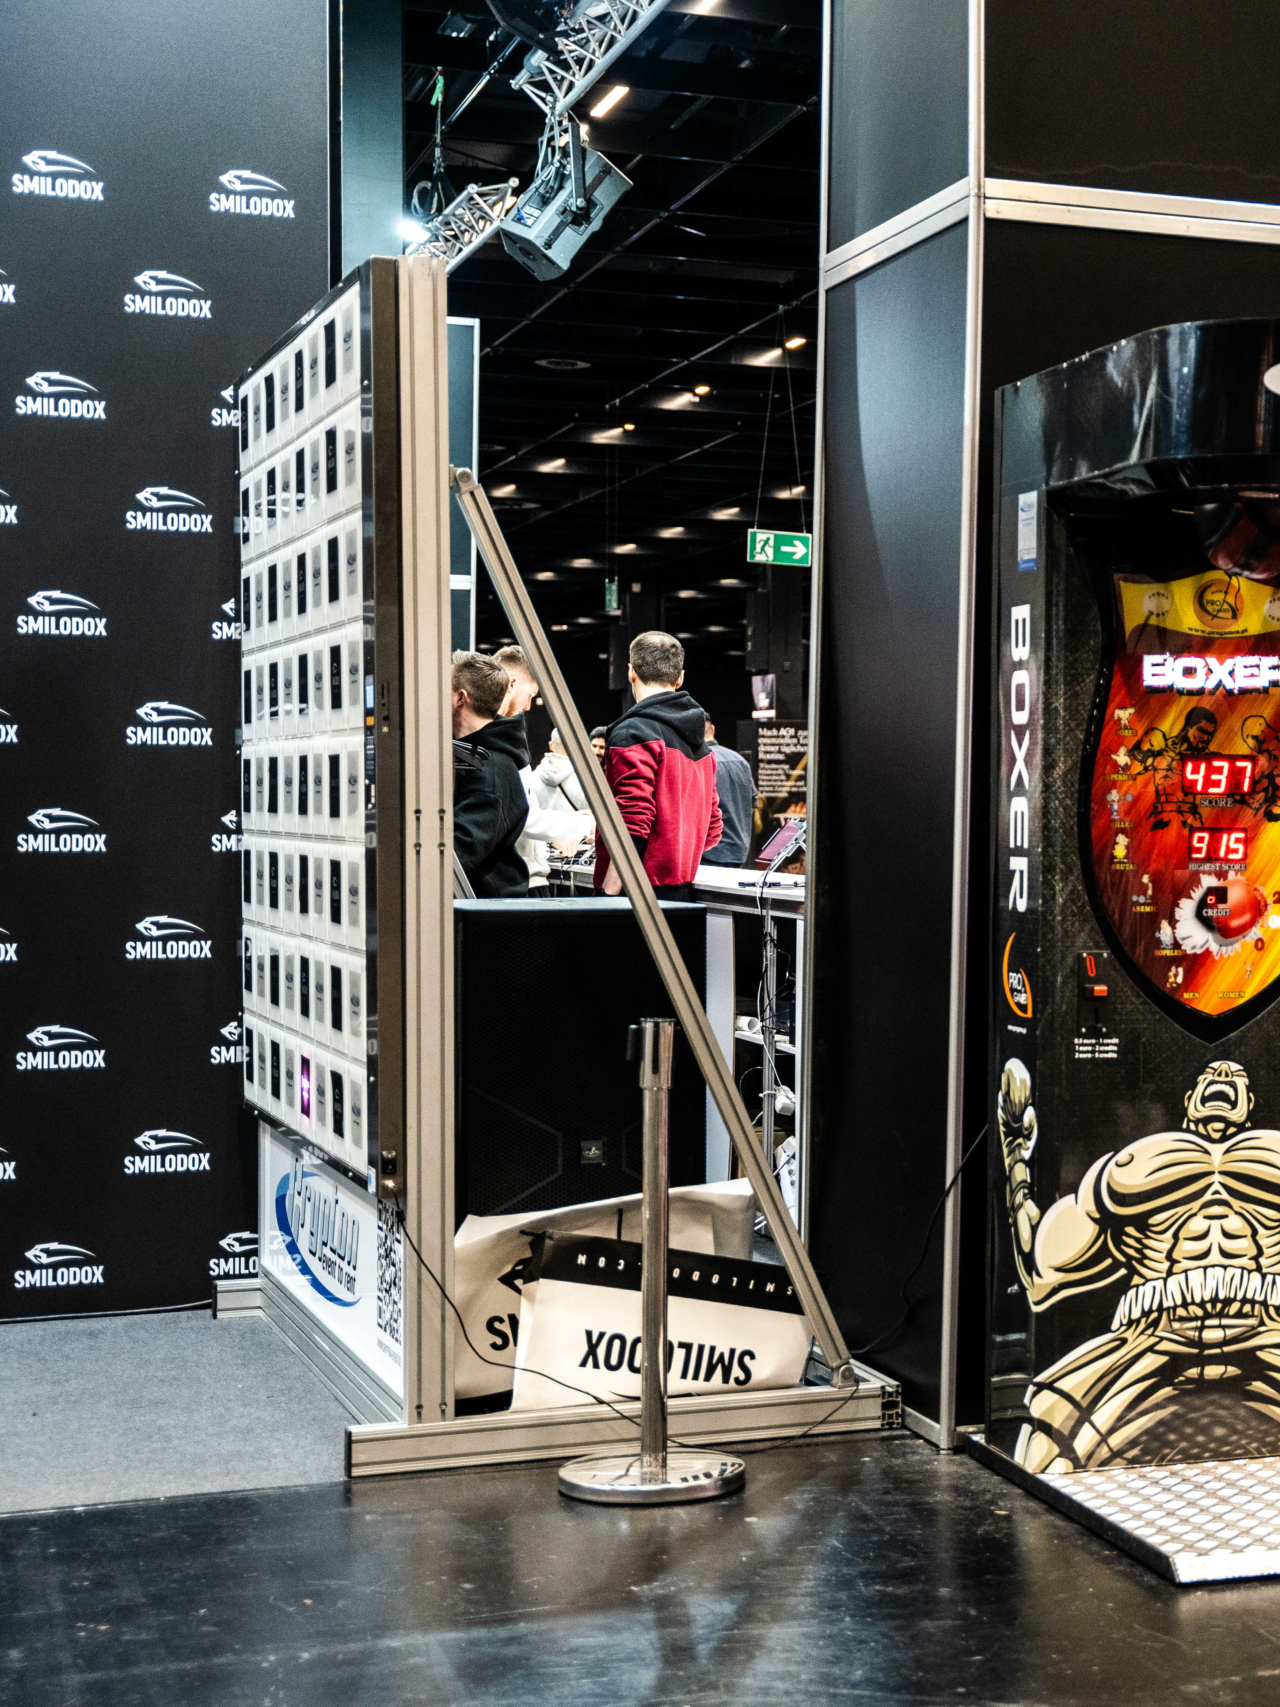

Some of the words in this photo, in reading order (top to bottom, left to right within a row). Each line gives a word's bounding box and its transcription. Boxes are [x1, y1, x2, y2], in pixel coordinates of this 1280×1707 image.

[12, 172, 104, 201] SMILODOX
[208, 191, 295, 218] SMILODOX
[123, 293, 212, 319] SMILODOX
[15, 394, 107, 420] SMILODOX
[125, 510, 213, 533] SMILODOX
[1205, 598, 1222, 607] PRO
[16, 614, 107, 637] SMILODOX
[125, 726, 213, 746] SMILODOX
[1009, 603, 1031, 913] BOXER
[1184, 760, 1253, 794] 437
[1200, 797, 1234, 807] SCORE
[16, 833, 107, 853] SMILODOX
[1190, 831, 1246, 859] 915
[1188, 862, 1220, 871] HIGHEST
[1221, 862, 1247, 871] SCORE
[1203, 908, 1231, 917] CREDIT
[125, 940, 212, 960] SMILODOX
[1254, 937, 1265, 952] 0
[1008, 971, 1023, 990] PRO
[1217, 991, 1246, 999] WOMEN
[15, 1049, 106, 1071] SMILODOX
[123, 1152, 211, 1175] SMILODOX
[13, 1264, 105, 1289] SMILODOX
[321, 1253, 337, 1279] event
[337, 1263, 345, 1286] to
[344, 1272, 357, 1296] rent
[578, 1328, 756, 1387] SMILDOX
